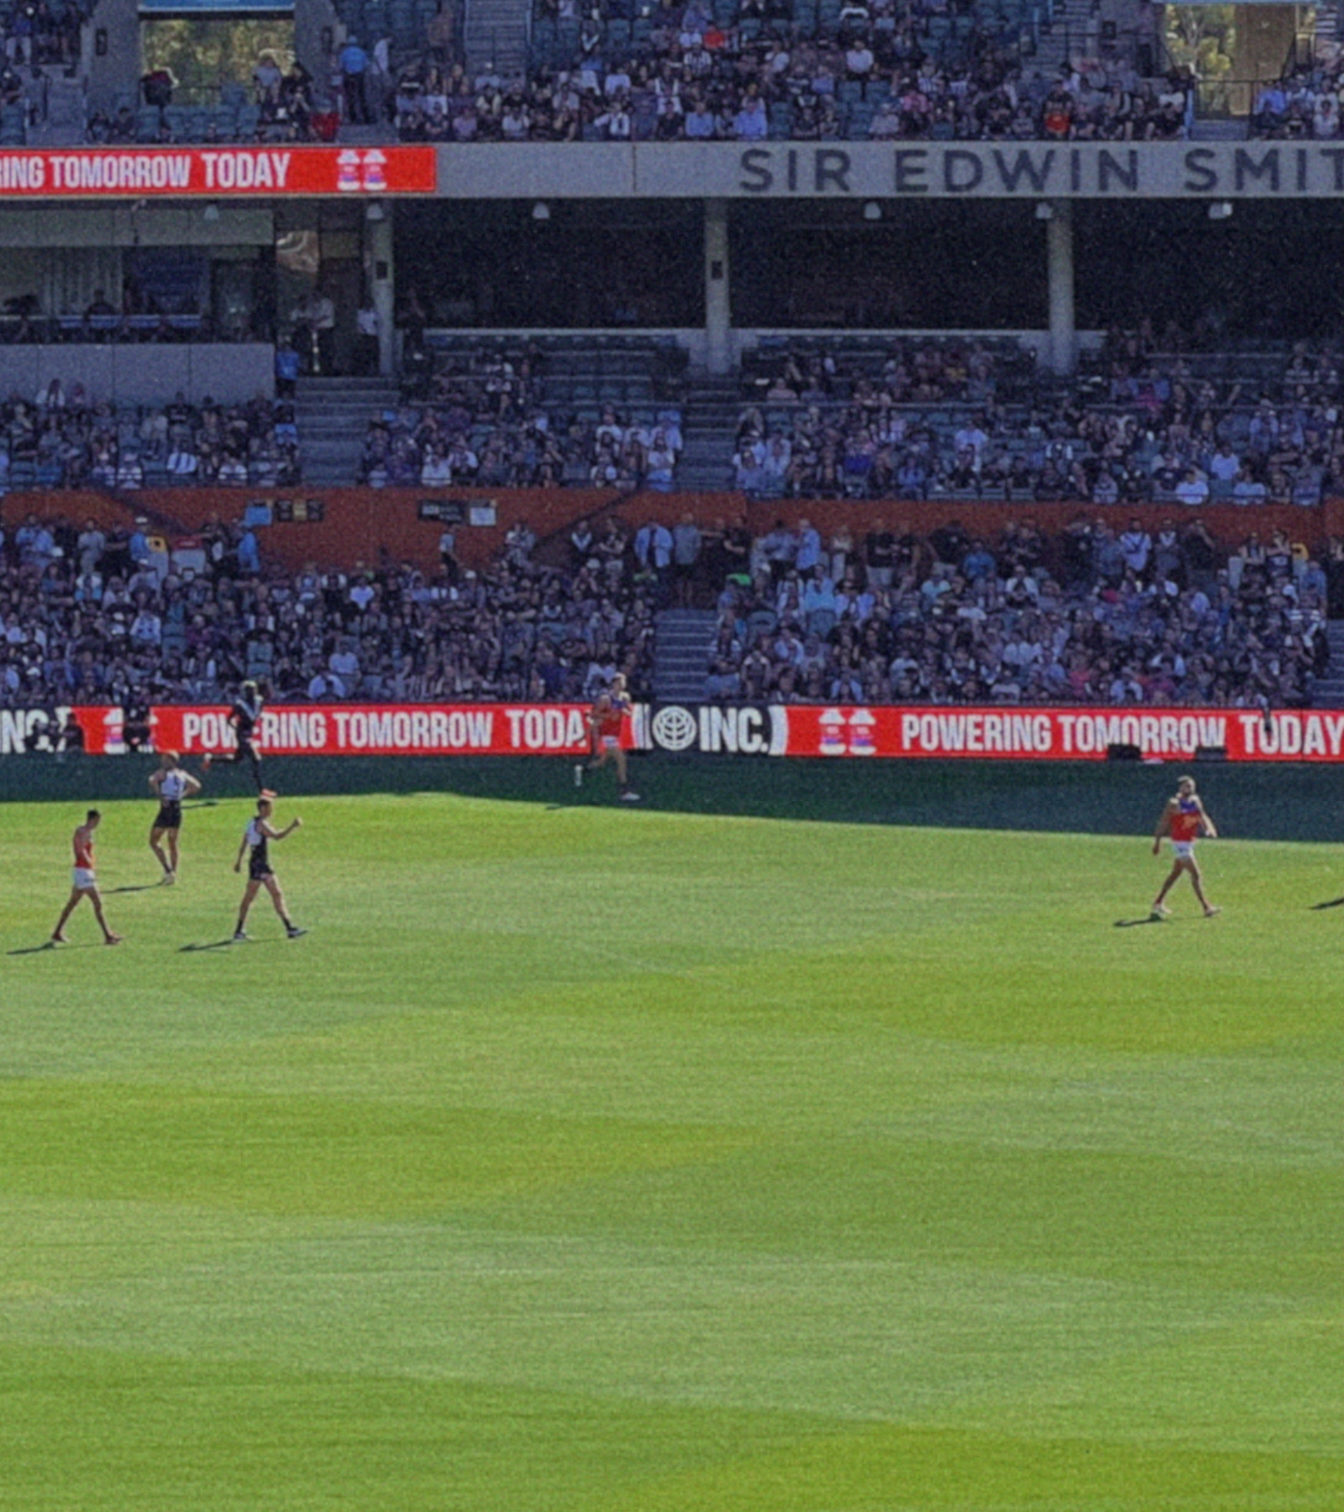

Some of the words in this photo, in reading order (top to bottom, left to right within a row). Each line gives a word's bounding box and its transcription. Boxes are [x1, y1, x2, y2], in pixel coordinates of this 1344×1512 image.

[49, 152, 190, 189] TOMORROW
[201, 151, 290, 189] TODAY
[738, 148, 852, 193] SIR
[894, 148, 1139, 193] EDWIN
[1184, 148, 1344, 192] SMIT
[332, 712, 493, 748] TOMORROW
[505, 709, 587, 748] TODA
[700, 706, 769, 752] INC.
[902, 713, 1052, 753] POWERING
[1057, 714, 1227, 753] TOMORROW
[1239, 714, 1344, 755] TODAY
